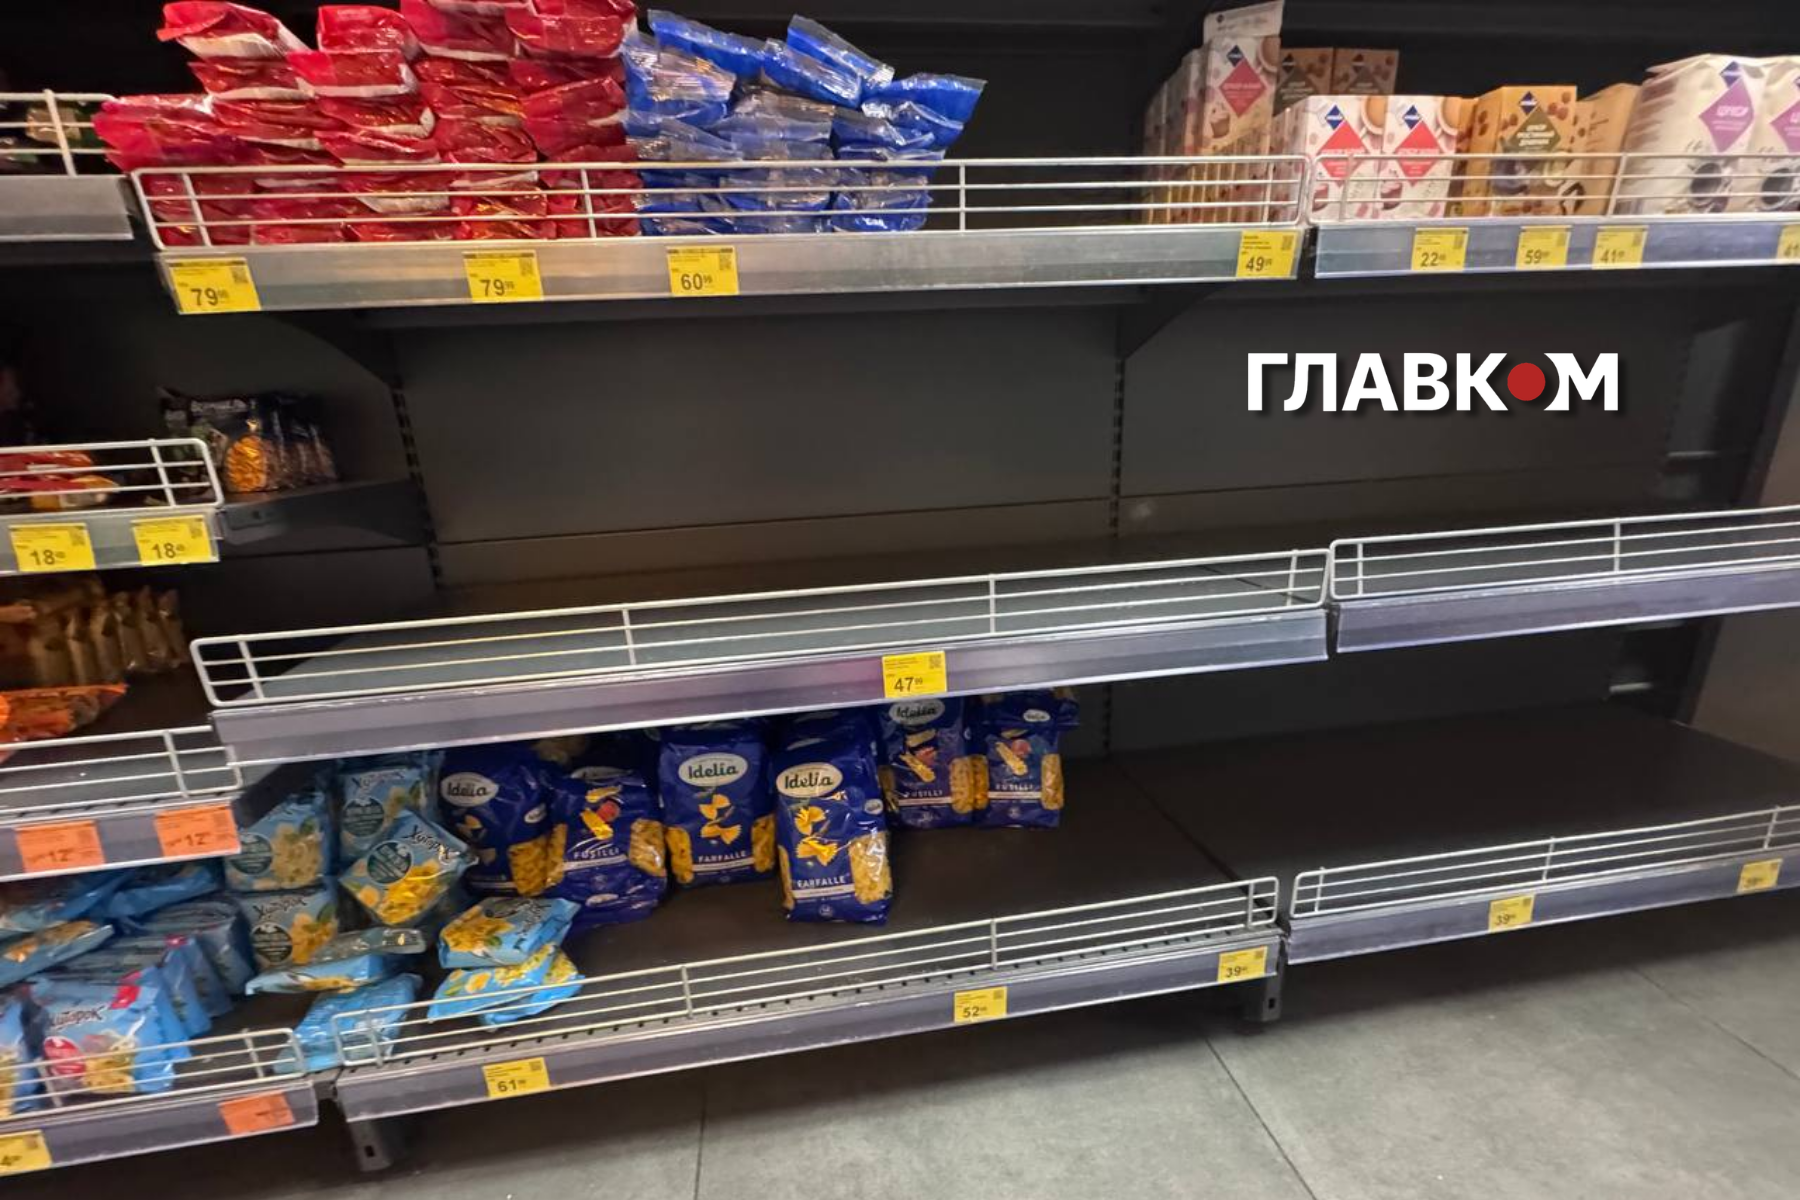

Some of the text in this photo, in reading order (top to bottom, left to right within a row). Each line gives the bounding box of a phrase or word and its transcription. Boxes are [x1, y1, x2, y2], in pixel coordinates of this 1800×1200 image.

[1245, 256, 1265, 272] 49
[1420, 251, 1439, 268] 22
[1524, 248, 1542, 265] 59
[479, 278, 505, 297] 79
[681, 273, 703, 291] 60
[190, 287, 219, 307] 79
[30, 549, 56, 566] 18
[152, 542, 177, 559] 18
[894, 676, 914, 693] 47
[688, 761, 738, 779] Idelia
[784, 771, 834, 790] Idelia
[698, 848, 747, 864] FARFALLE
[796, 874, 847, 889] FARFALLE
[963, 1006, 980, 1018] 52
[498, 1080, 516, 1092] 61
